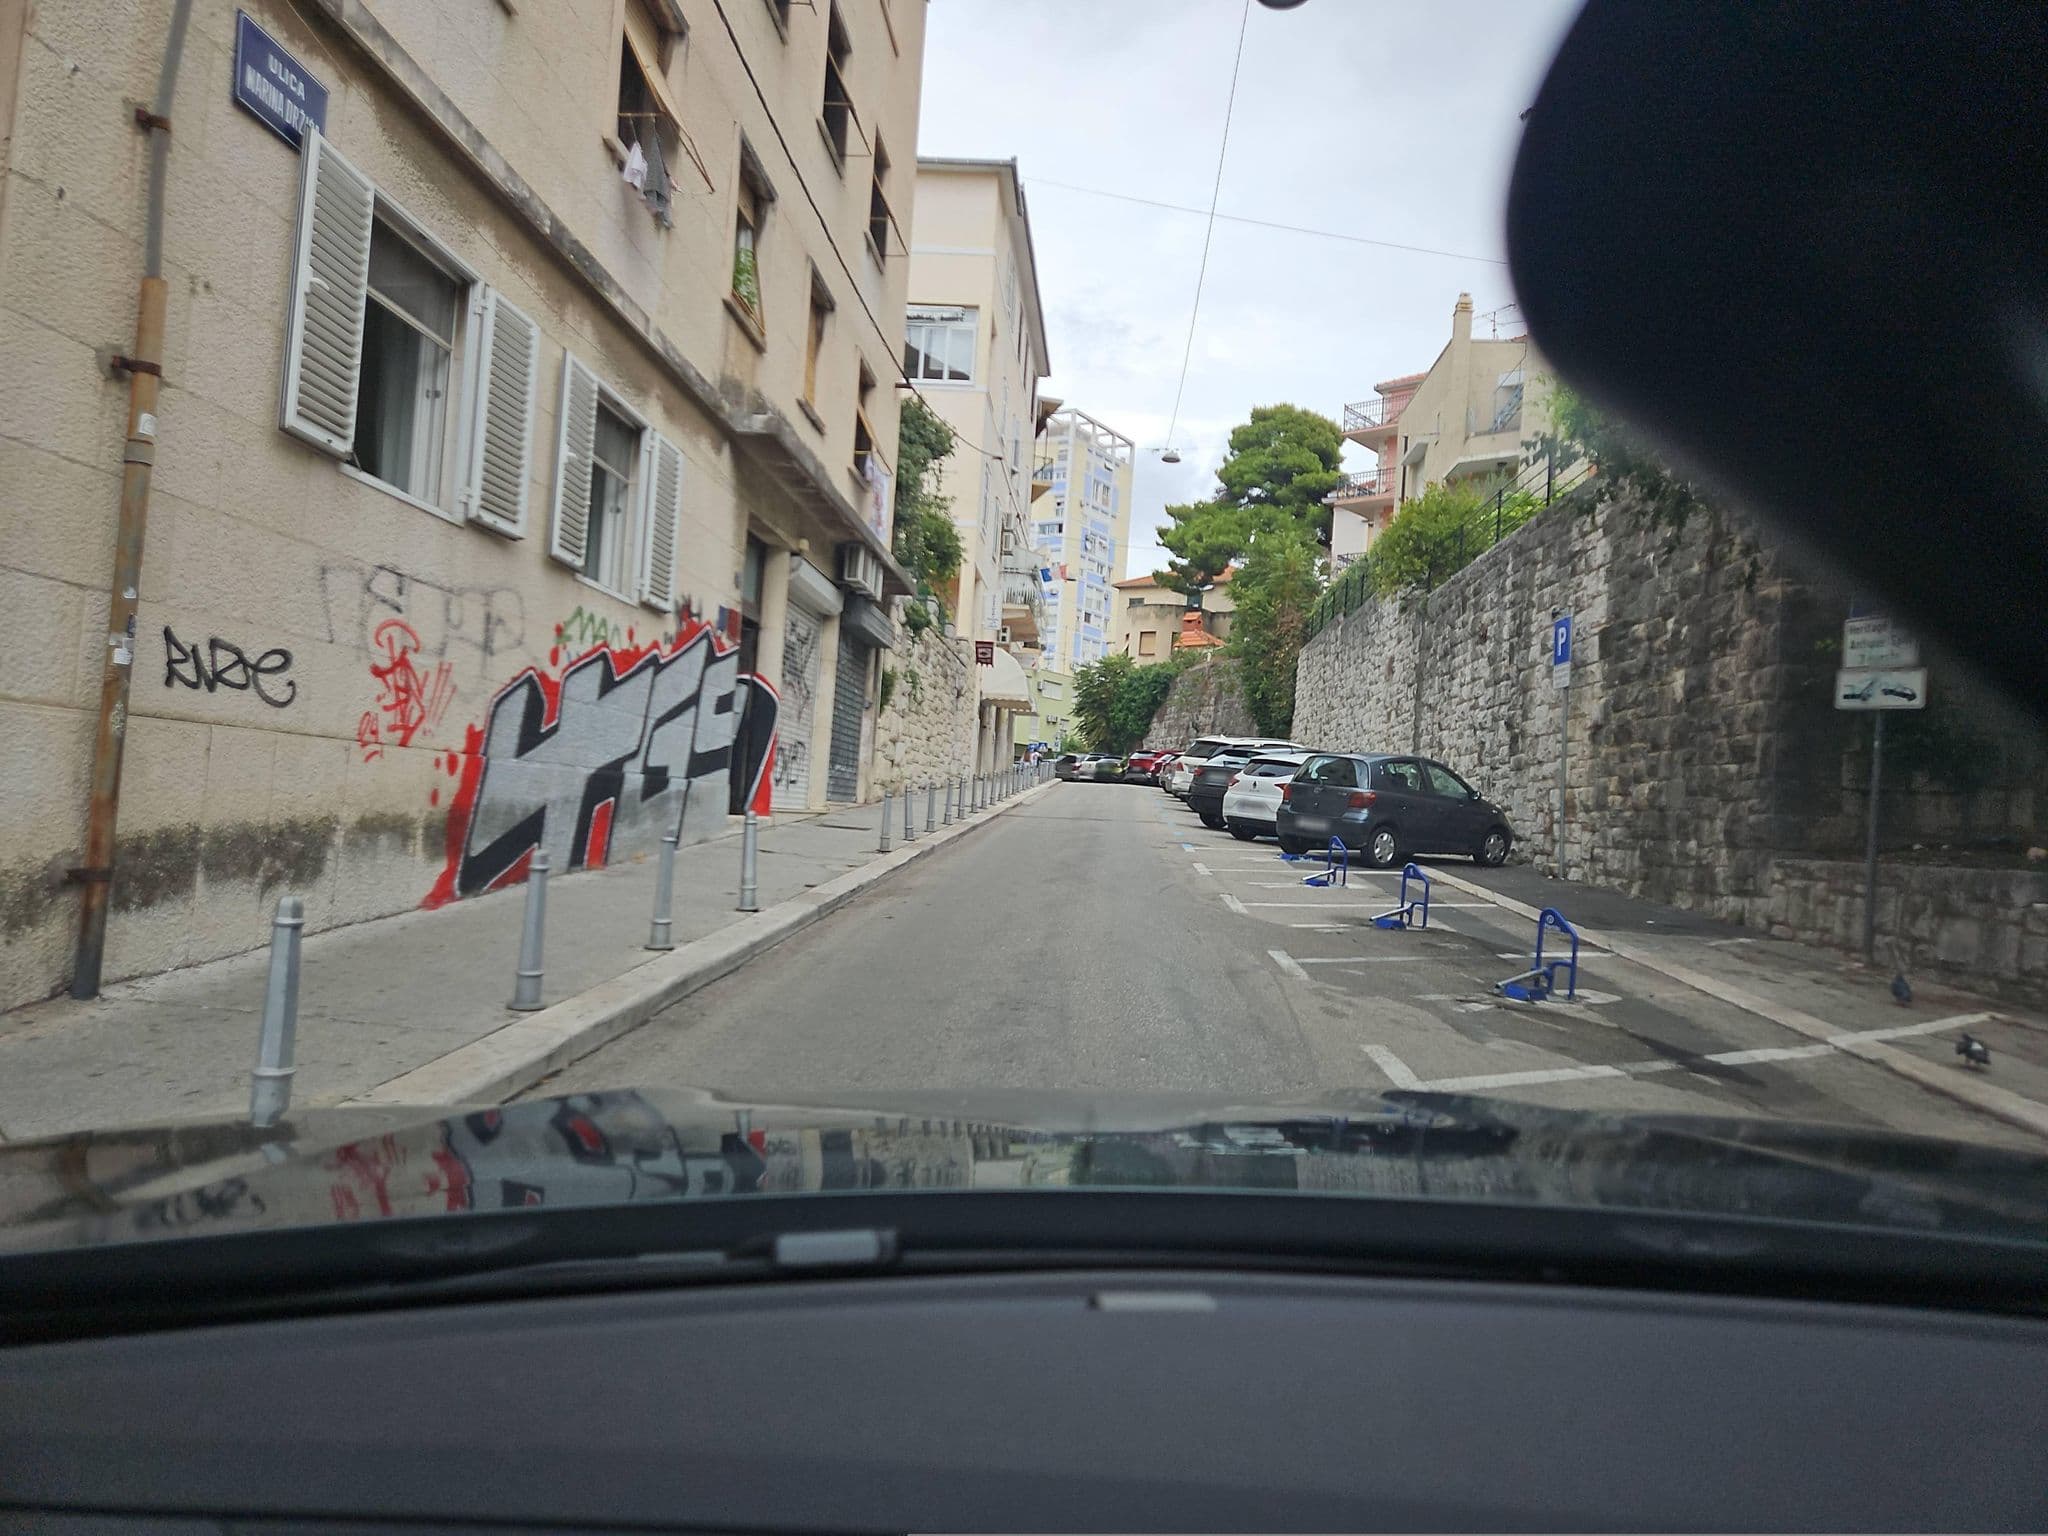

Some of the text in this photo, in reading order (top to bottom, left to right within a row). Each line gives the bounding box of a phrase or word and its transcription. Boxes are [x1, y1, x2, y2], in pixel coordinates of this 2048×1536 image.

[244, 62, 320, 137] MARINA DRŽ
[267, 52, 306, 102] ULICA
[1557, 626, 1567, 657] P
